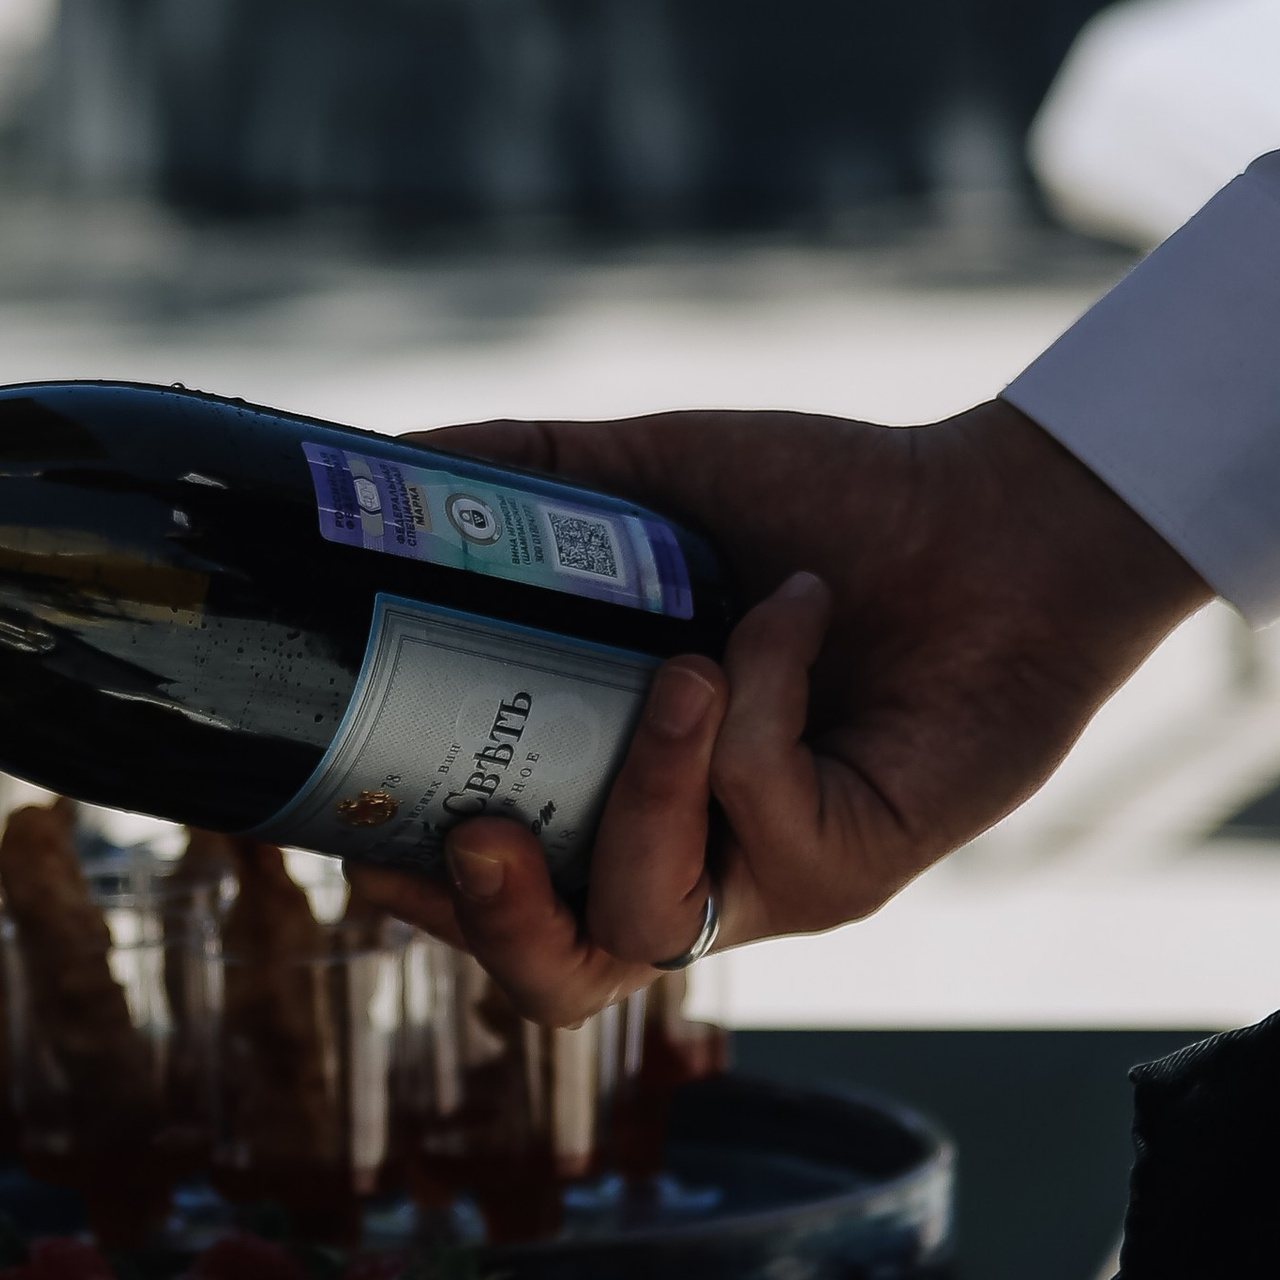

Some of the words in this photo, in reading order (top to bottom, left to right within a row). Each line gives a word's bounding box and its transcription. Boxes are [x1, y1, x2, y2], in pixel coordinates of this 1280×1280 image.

[379, 464, 405, 544] ФЕДЕРАЛЬНАЯ
[390, 466, 417, 547] СПЕЦИАЛЬНАЯ
[409, 487, 425, 527] МАРКА
[509, 538, 520, 564] ВИНА
[381, 774, 402, 790] 78
